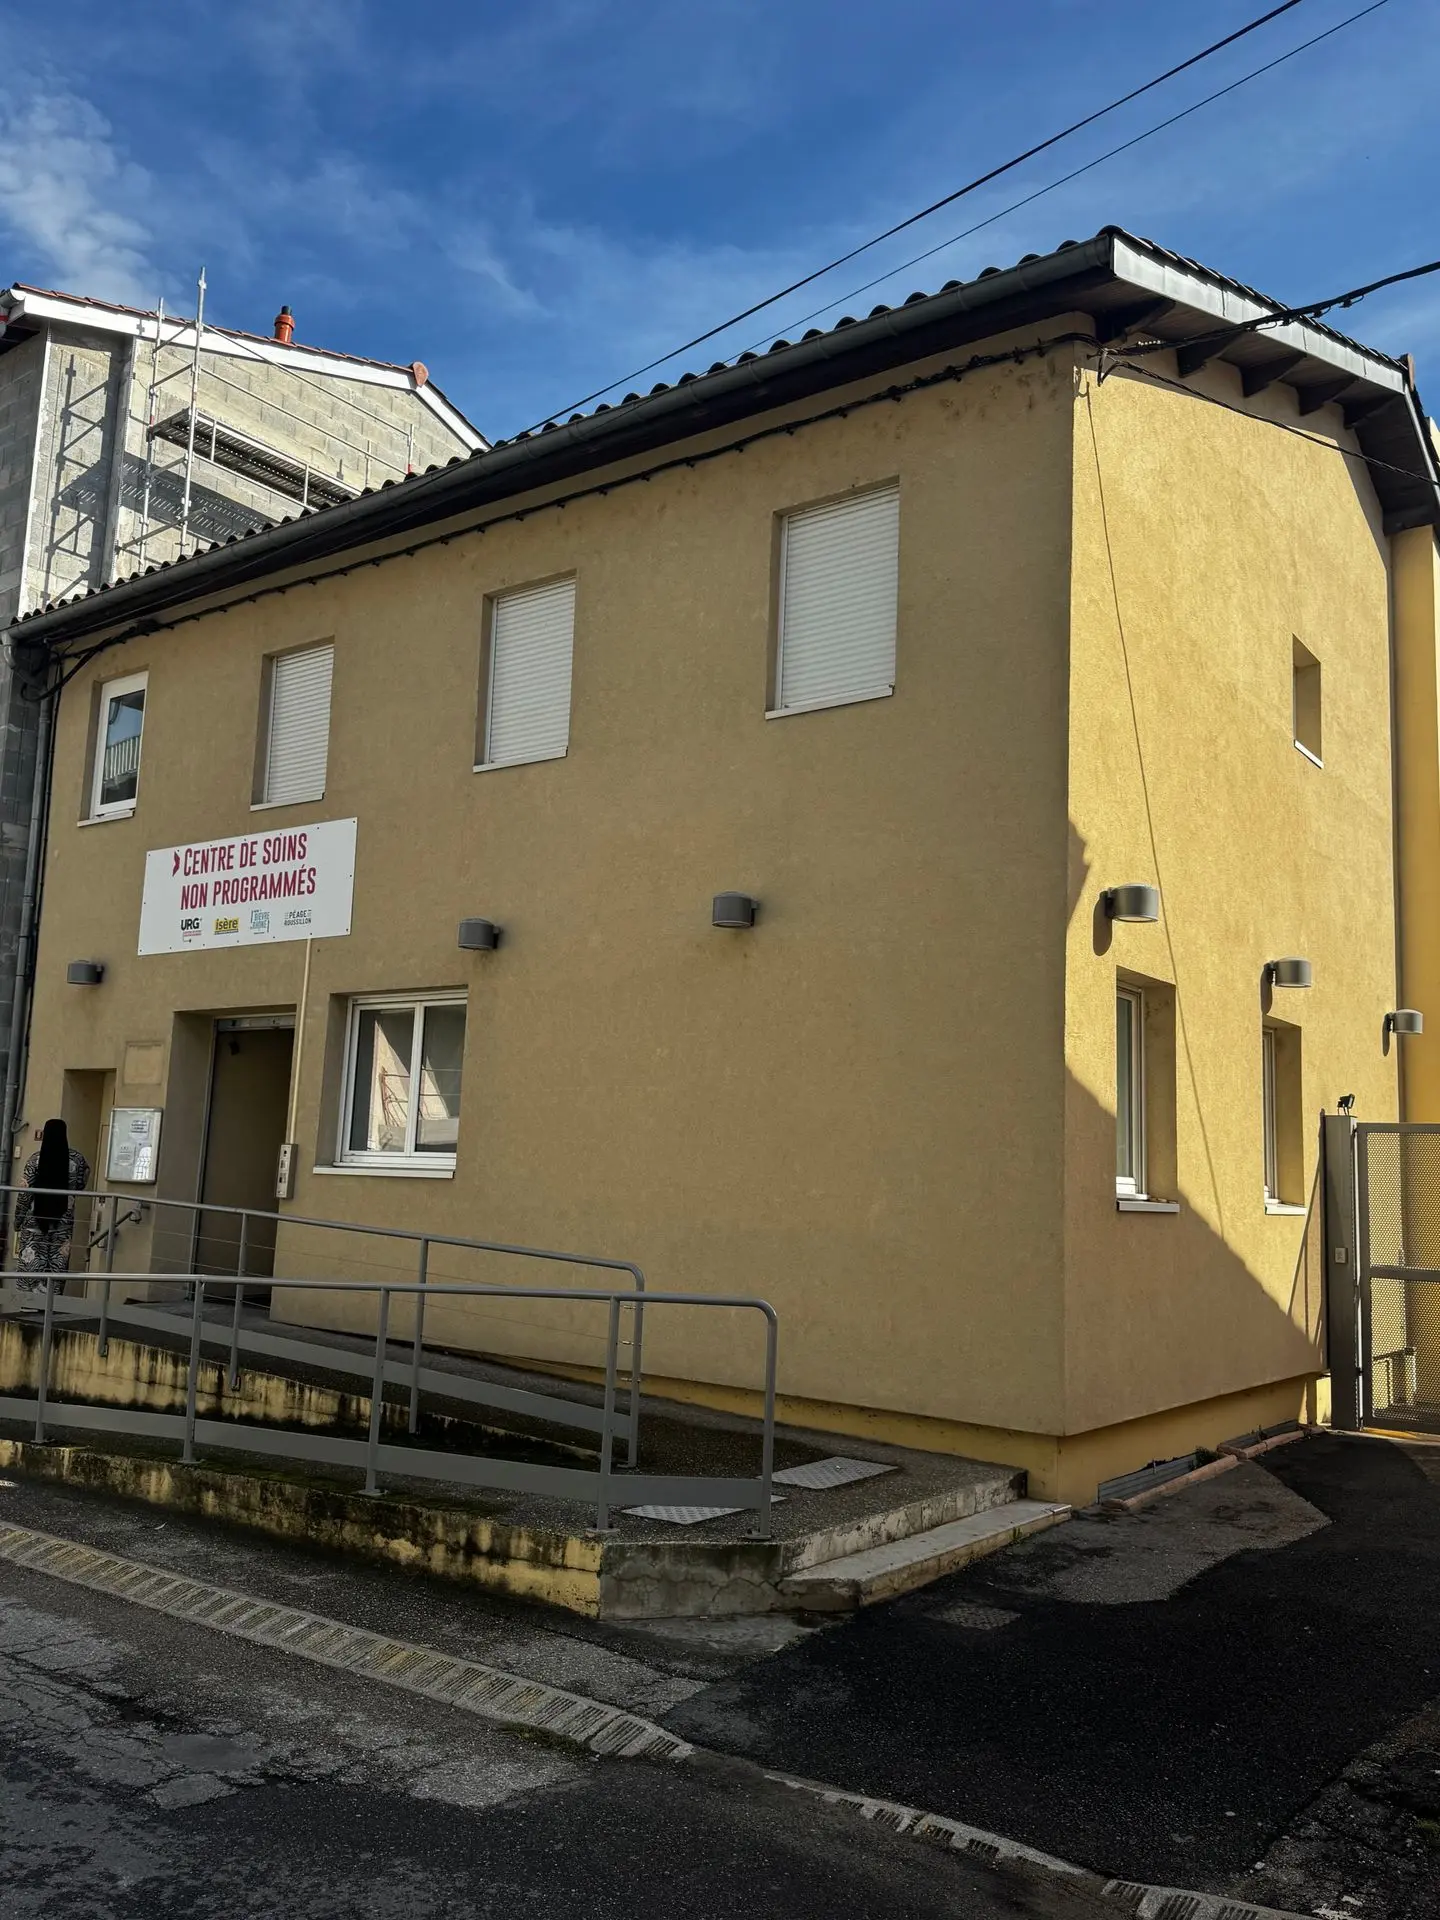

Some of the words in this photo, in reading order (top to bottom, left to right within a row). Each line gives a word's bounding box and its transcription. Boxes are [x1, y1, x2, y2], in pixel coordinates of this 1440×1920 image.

[184, 845, 236, 876] CENTRE
[239, 840, 258, 868] DE
[262, 833, 308, 865] SOINS
[181, 882, 208, 910] NON
[213, 865, 317, 907] PROGRAMMÉS
[215, 917, 238, 930] isère
[284, 917, 311, 926] ROUSSILLON
